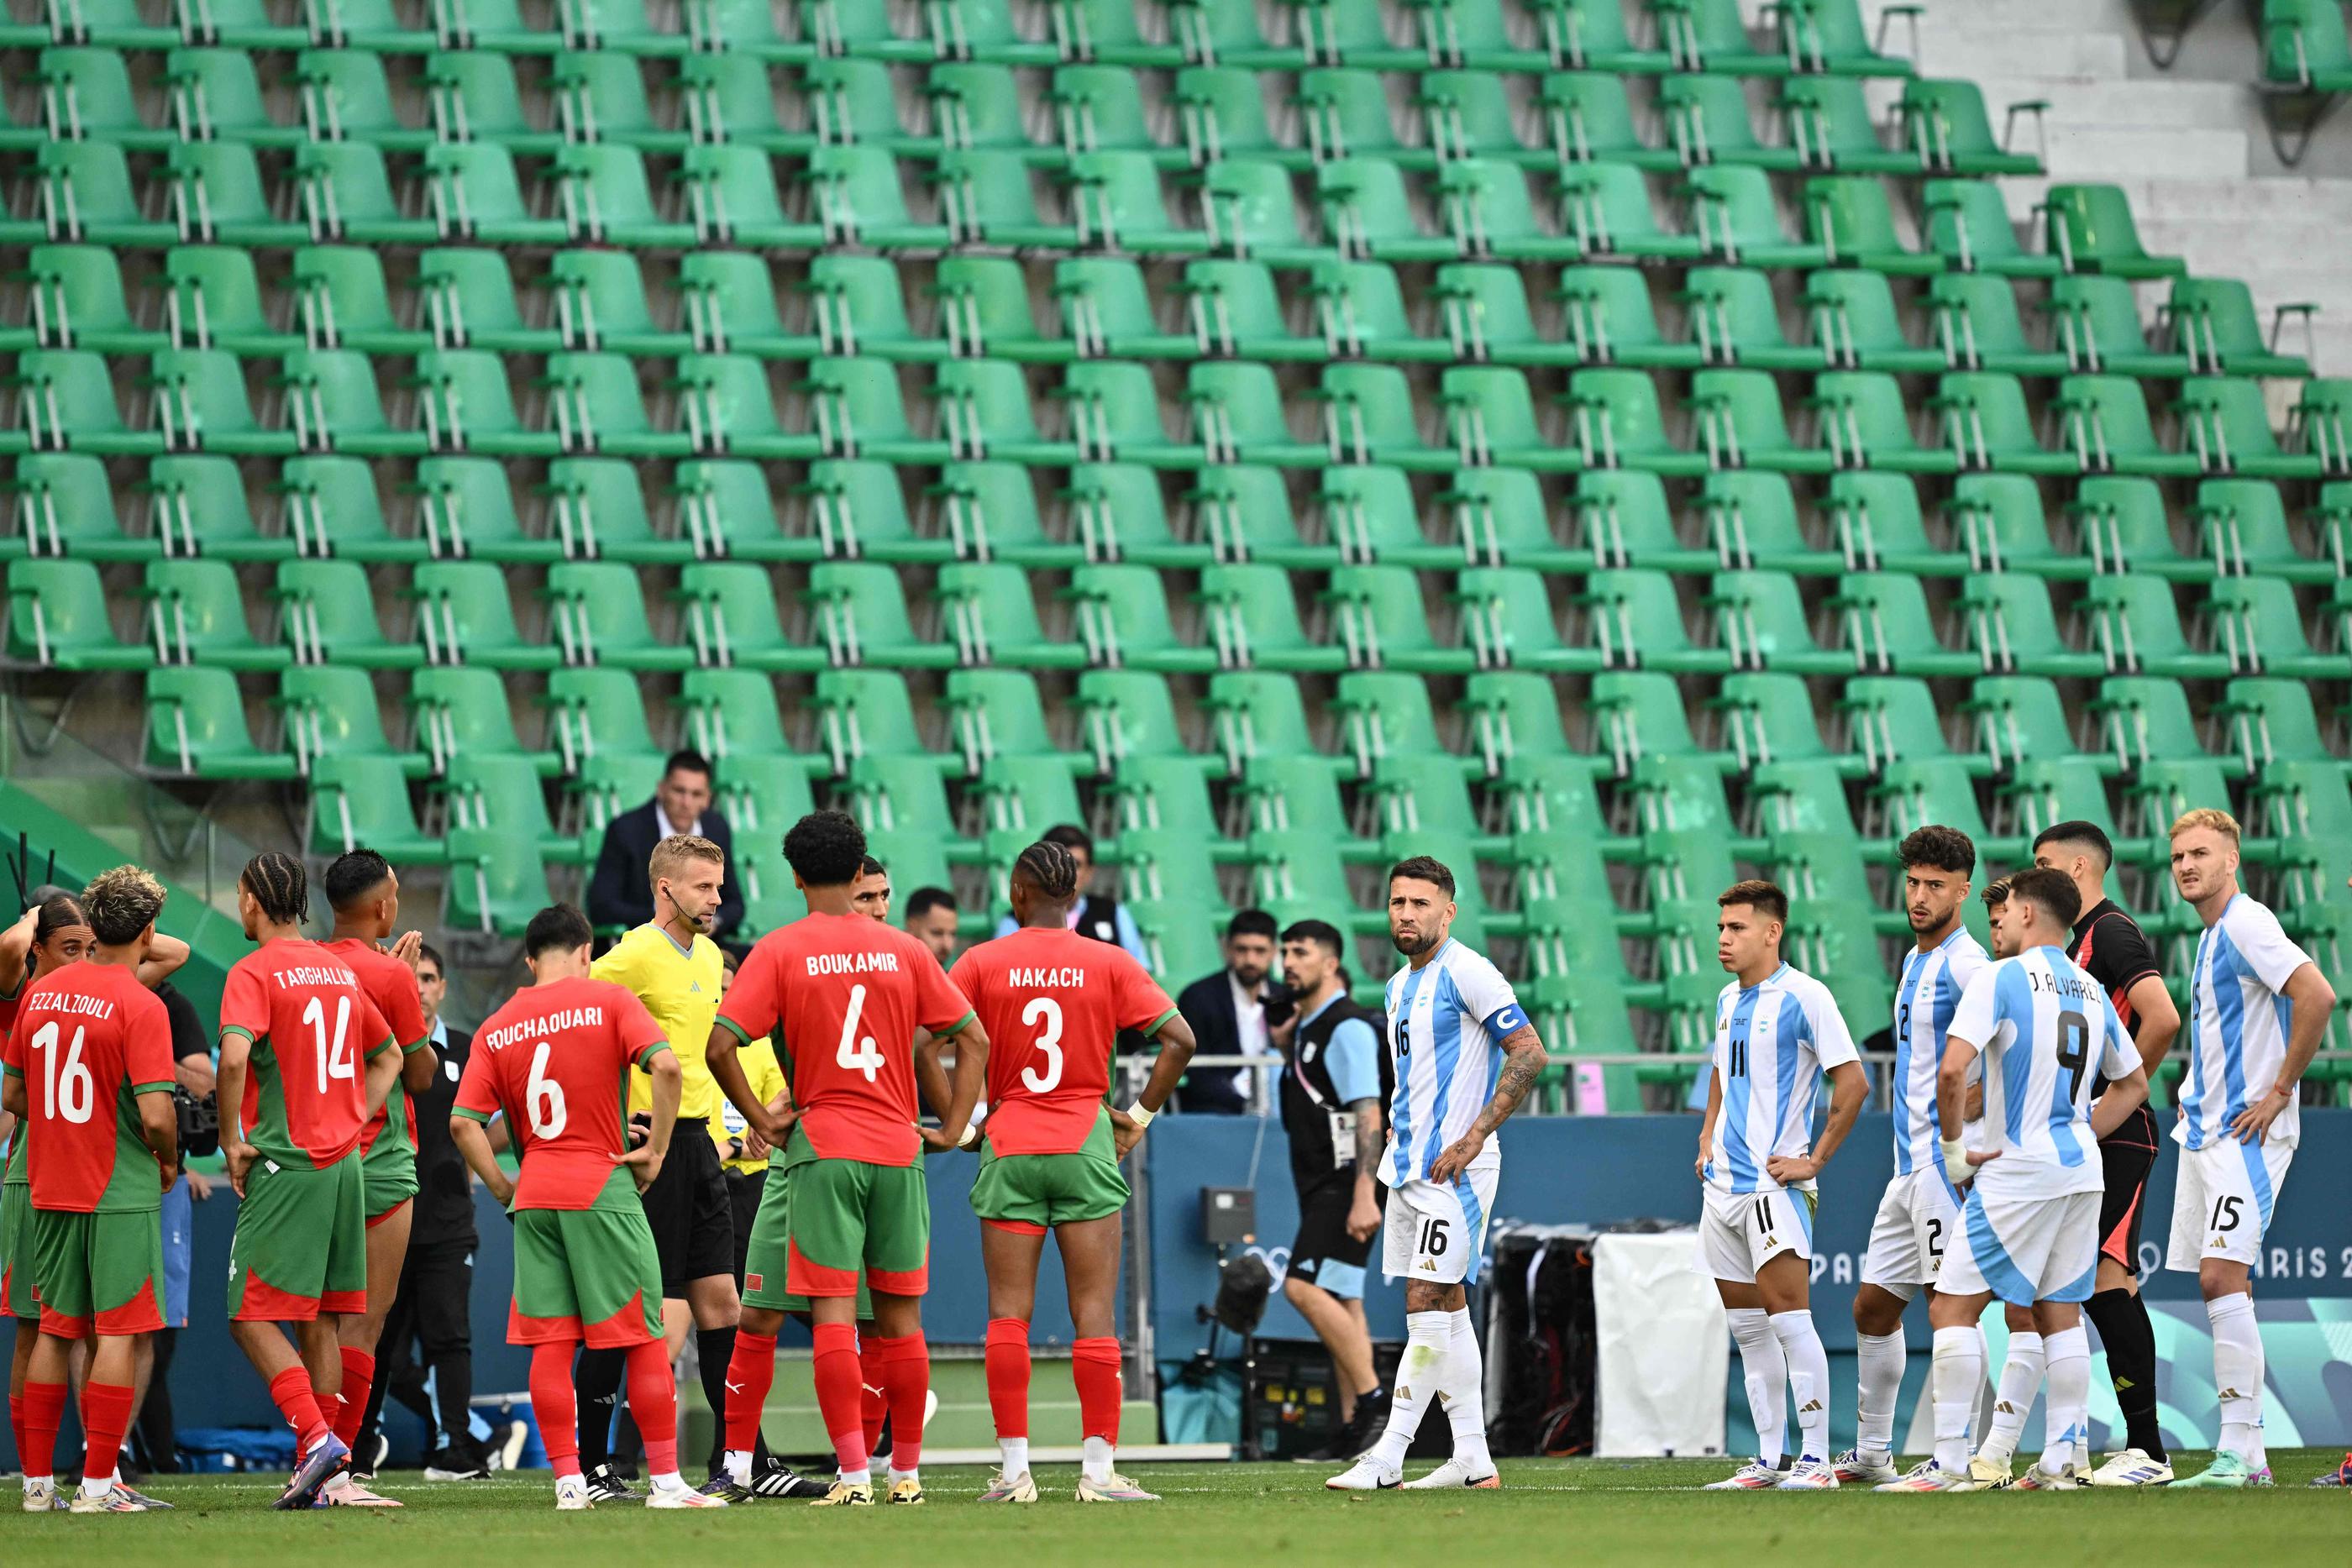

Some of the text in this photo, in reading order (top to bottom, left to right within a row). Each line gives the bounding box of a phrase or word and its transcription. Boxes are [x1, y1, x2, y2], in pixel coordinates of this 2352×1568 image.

[806, 952, 899, 976] BOUKAMIR
[1009, 968, 1084, 988] NAKACH
[29, 992, 113, 1020] EZZALZOULI
[1496, 1009, 1519, 1030] C
[1899, 1003, 1908, 1041] 2
[302, 995, 354, 1093] 14
[836, 983, 885, 1083] 4
[1021, 997, 1063, 1093] 3
[1394, 1019, 1410, 1058] 16
[31, 1020, 93, 1124] 16
[1730, 1040, 1745, 1078] 11
[2056, 1010, 2088, 1106] 9
[526, 1041, 567, 1140] 6
[1755, 1195, 1774, 1235] 11
[2210, 1195, 2244, 1232] 15
[1419, 1218, 1450, 1256] 16
[1926, 1218, 1944, 1256] 2
